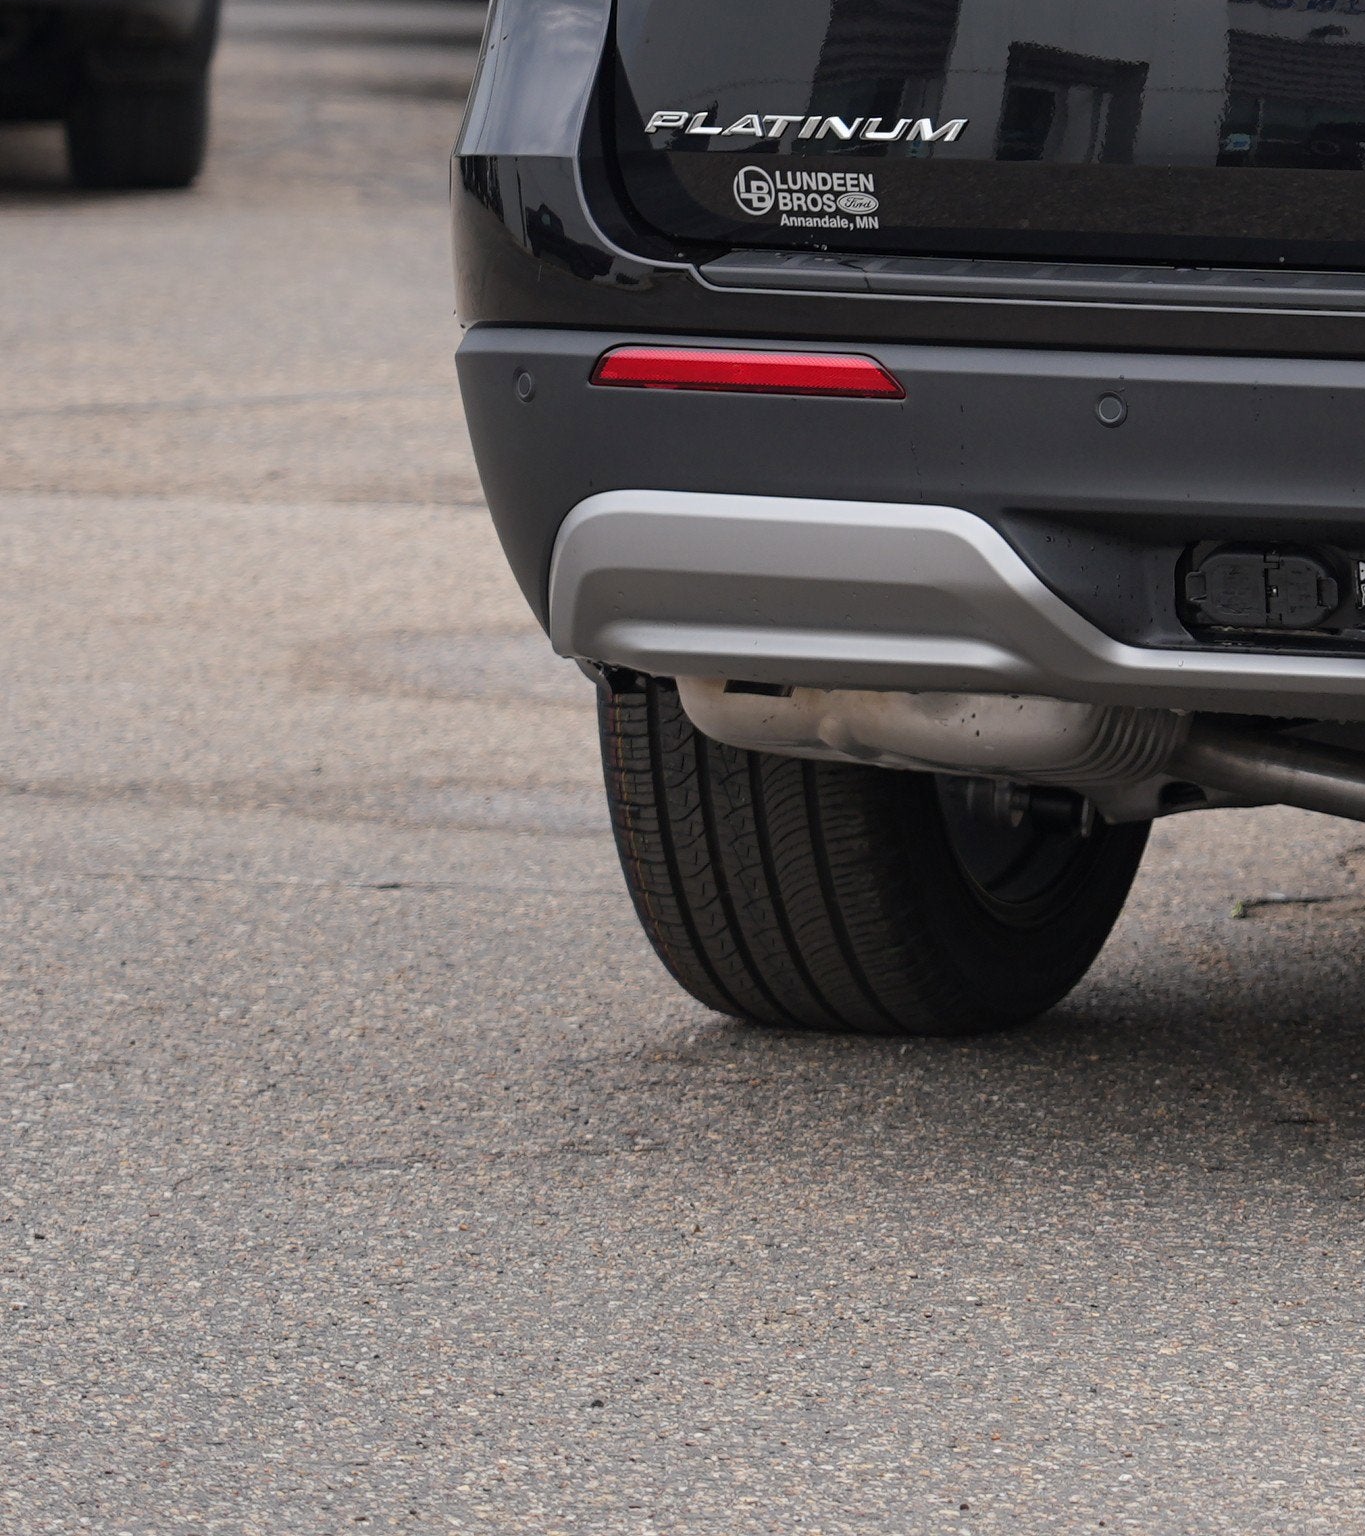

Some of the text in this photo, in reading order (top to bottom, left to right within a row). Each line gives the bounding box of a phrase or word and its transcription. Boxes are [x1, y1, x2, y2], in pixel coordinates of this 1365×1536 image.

[644, 110, 969, 143] PLATINUM
[775, 170, 875, 192] LUNDEEN
[777, 191, 837, 213] BROS
[780, 213, 879, 231] Annandale, MN
